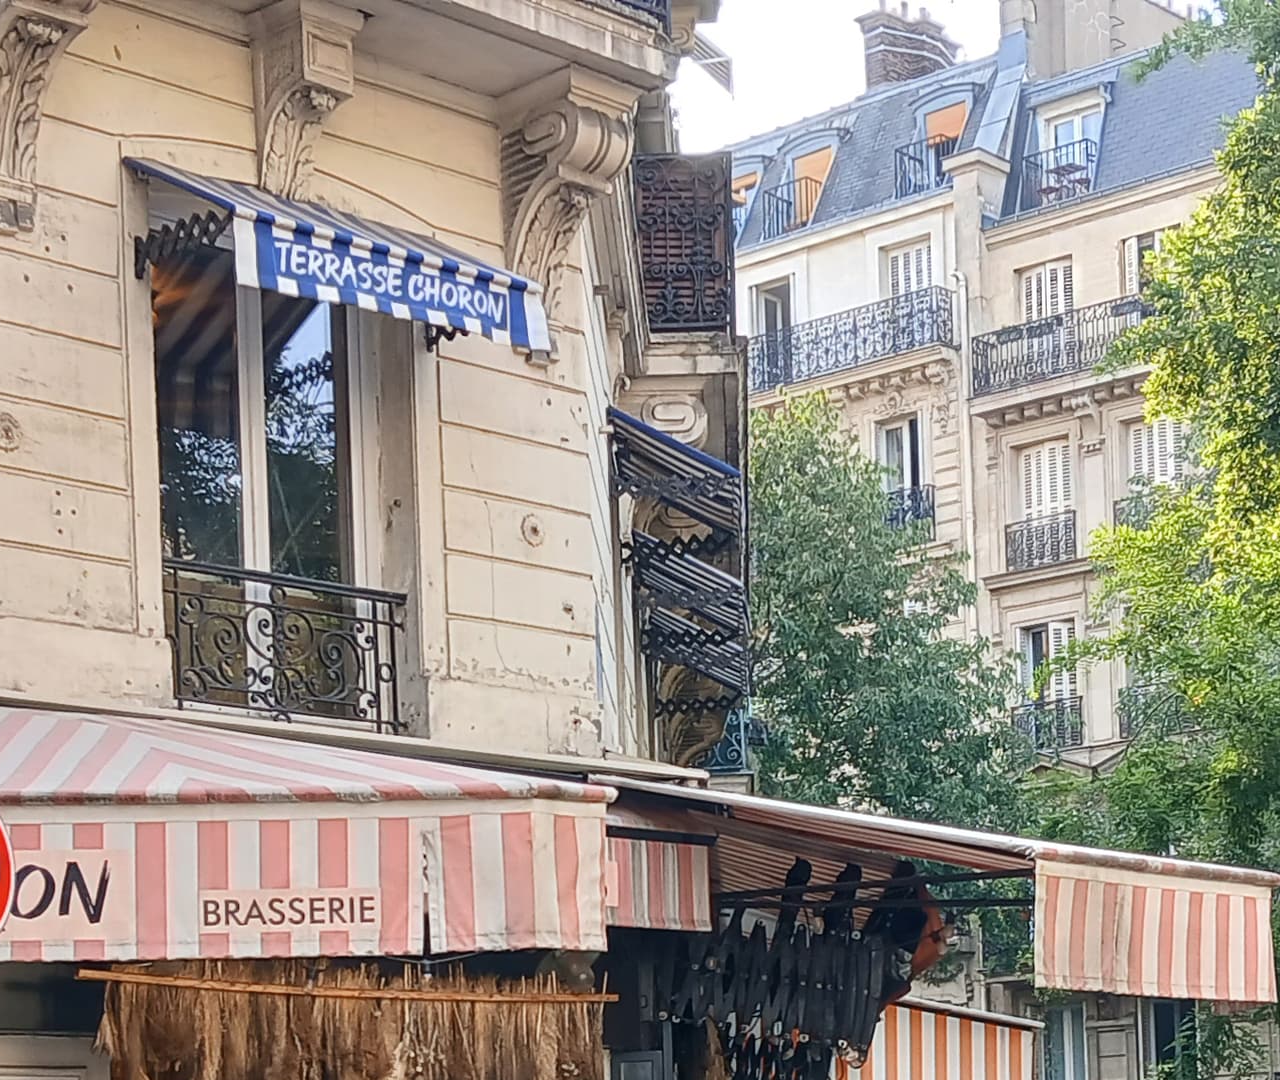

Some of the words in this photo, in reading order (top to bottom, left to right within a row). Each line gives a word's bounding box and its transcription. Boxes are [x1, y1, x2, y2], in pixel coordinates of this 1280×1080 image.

[274, 241, 403, 297] TERRASSE
[407, 273, 504, 324] CHORON
[202, 896, 376, 927] BRASSERIE
